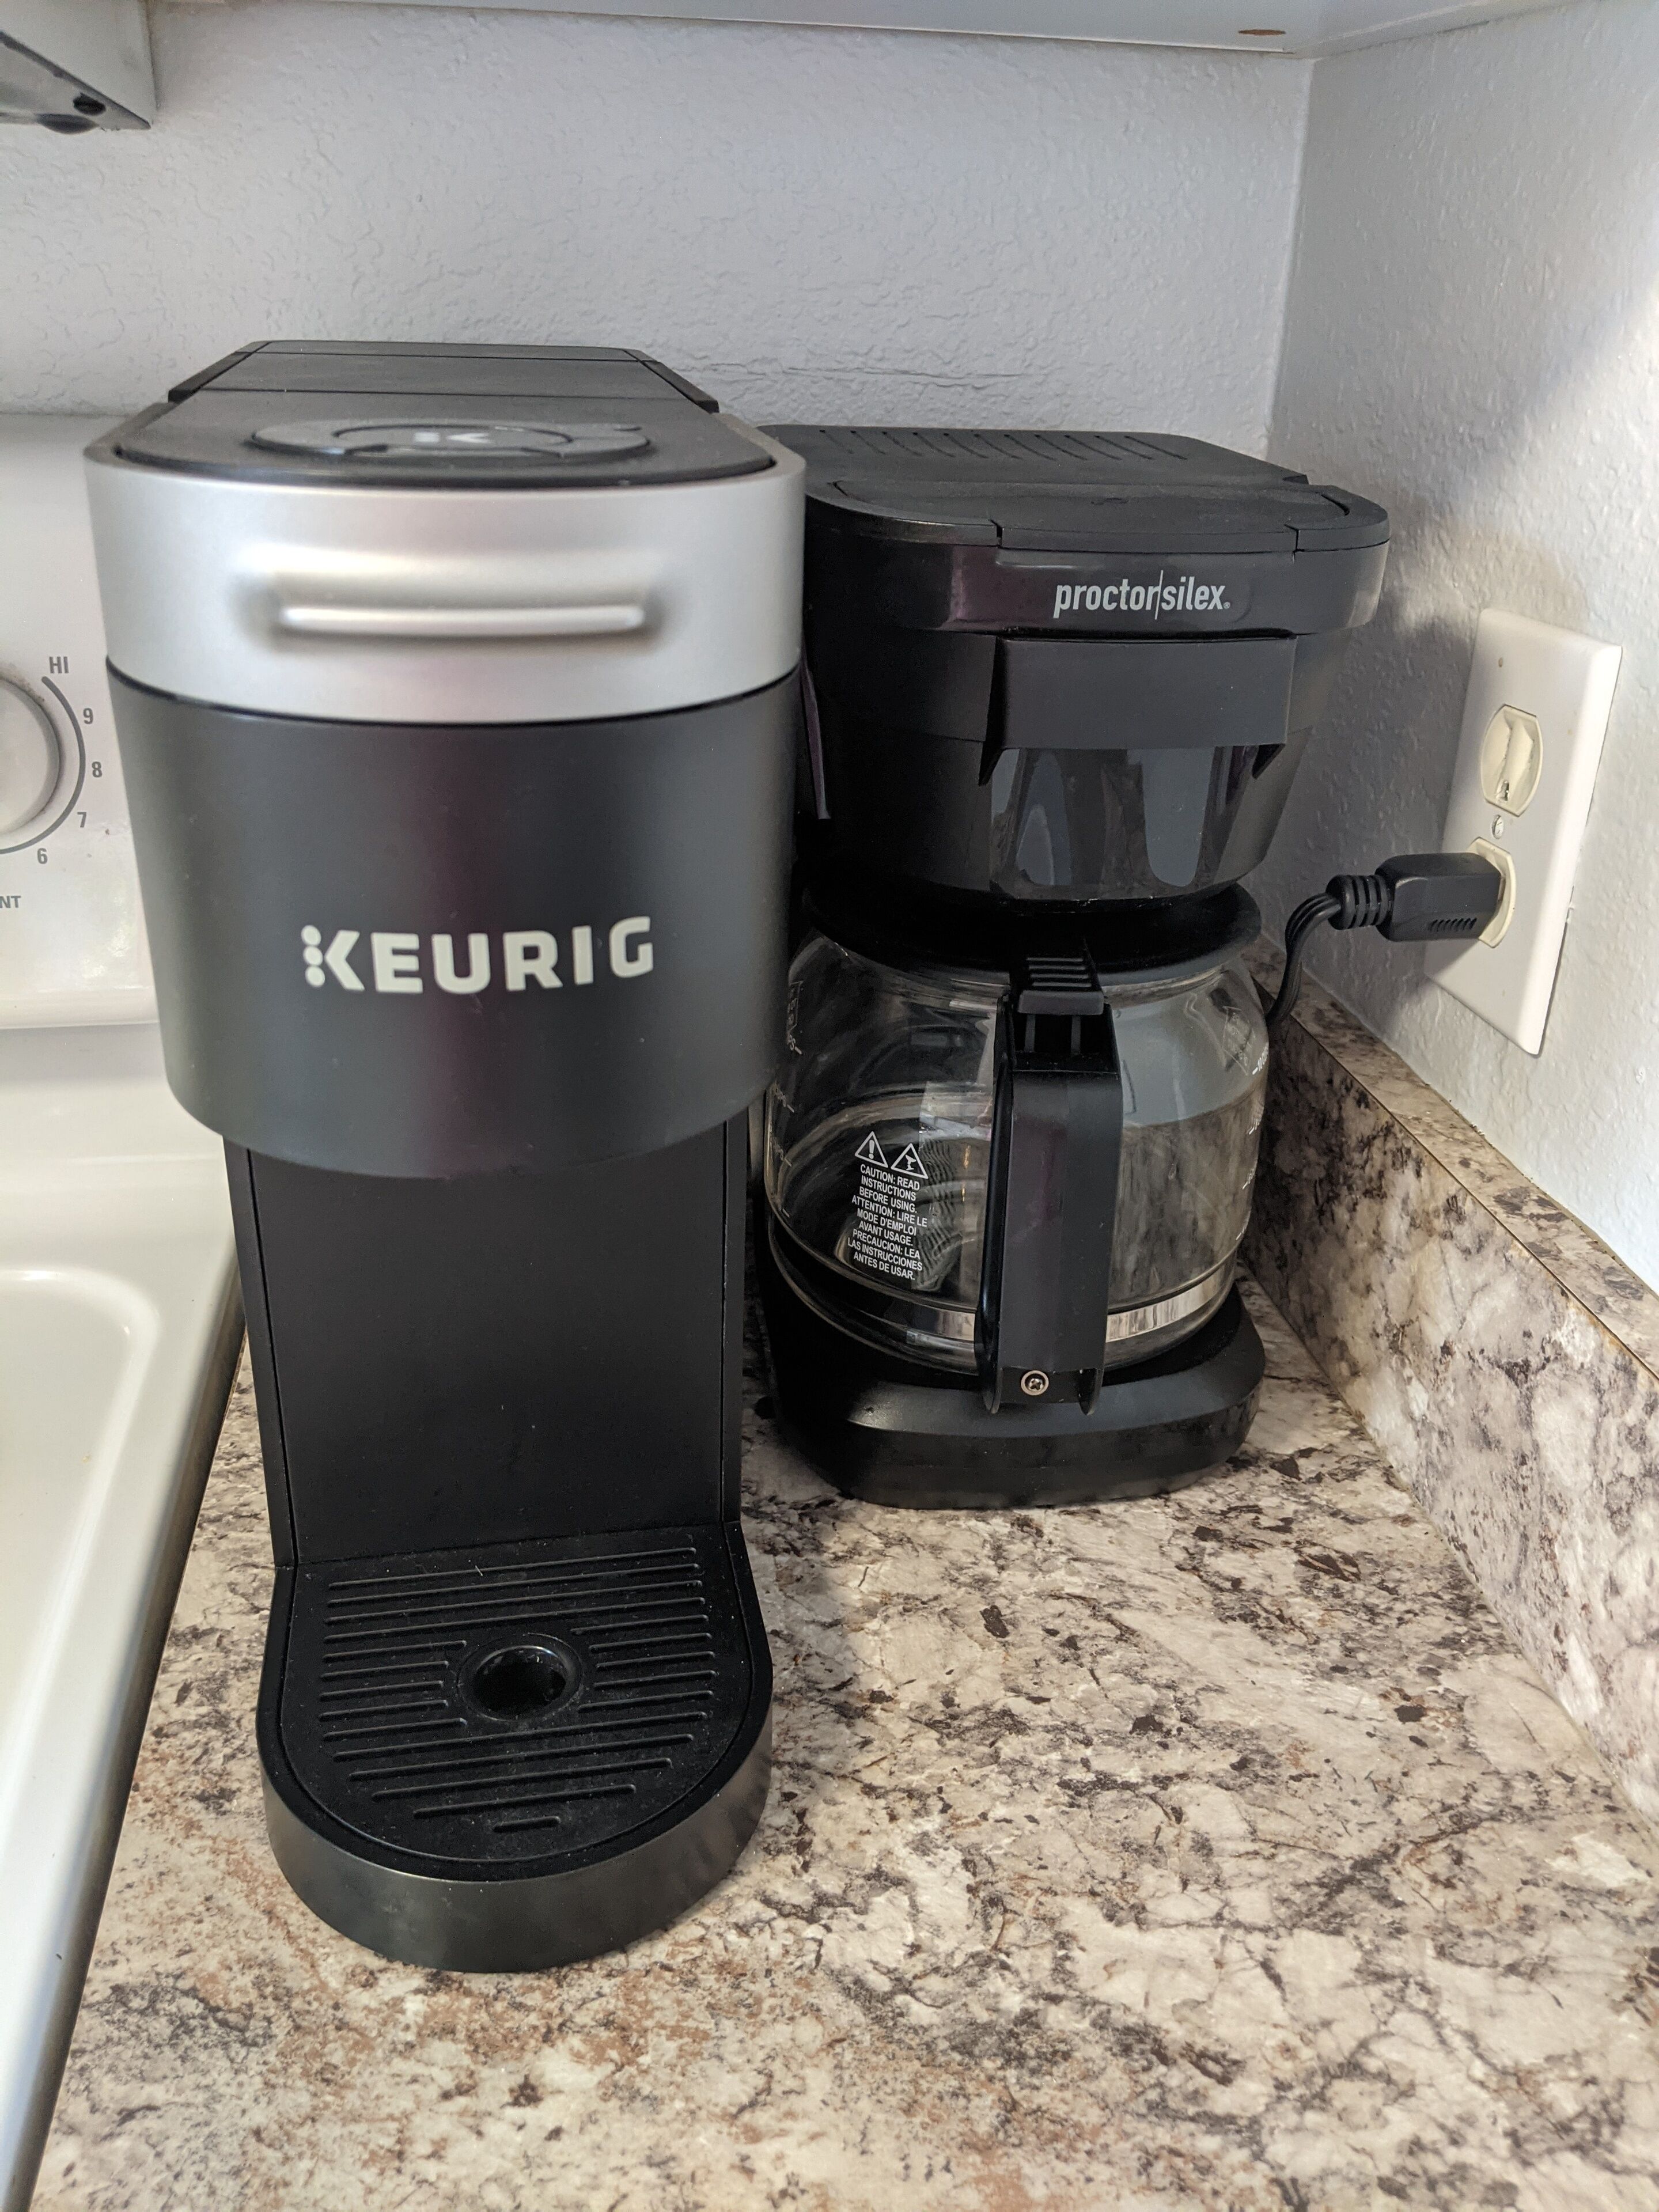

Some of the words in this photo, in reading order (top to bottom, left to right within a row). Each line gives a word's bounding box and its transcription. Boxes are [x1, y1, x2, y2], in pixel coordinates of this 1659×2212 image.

[49, 656, 70, 674] HI
[83, 708, 94, 724] 9
[92, 762, 103, 778] 8
[77, 812, 88, 828] 7
[37, 848, 48, 865] 6
[301, 916, 653, 994] KEURIG
[861, 1164, 896, 1184] CAUTION:
[897, 1176, 920, 1191] READ
[861, 1175, 916, 1201] INSTRUCTIONS
[852, 1194, 895, 1219] ATTENTION:
[897, 1211, 915, 1225] LIRE
[917, 1216, 928, 1228] LE
[859, 1186, 888, 1205] BEFORE
[891, 1197, 918, 1214] USING.
[857, 1208, 878, 1224] MODE
[880, 1217, 917, 1236] D'EMPLOI
[859, 1221, 883, 1236] AVANT
[884, 1229, 914, 1246] USAGE.
[848, 1237, 861, 1251] LAS
[862, 1244, 923, 1271] INSTRUCCIONES
[853, 1229, 903, 1255] PRECAUCION:
[904, 1247, 921, 1260] LEA
[854, 1251, 878, 1268] ANTES
[879, 1262, 889, 1272] DE
[891, 1265, 915, 1281] USAR.
